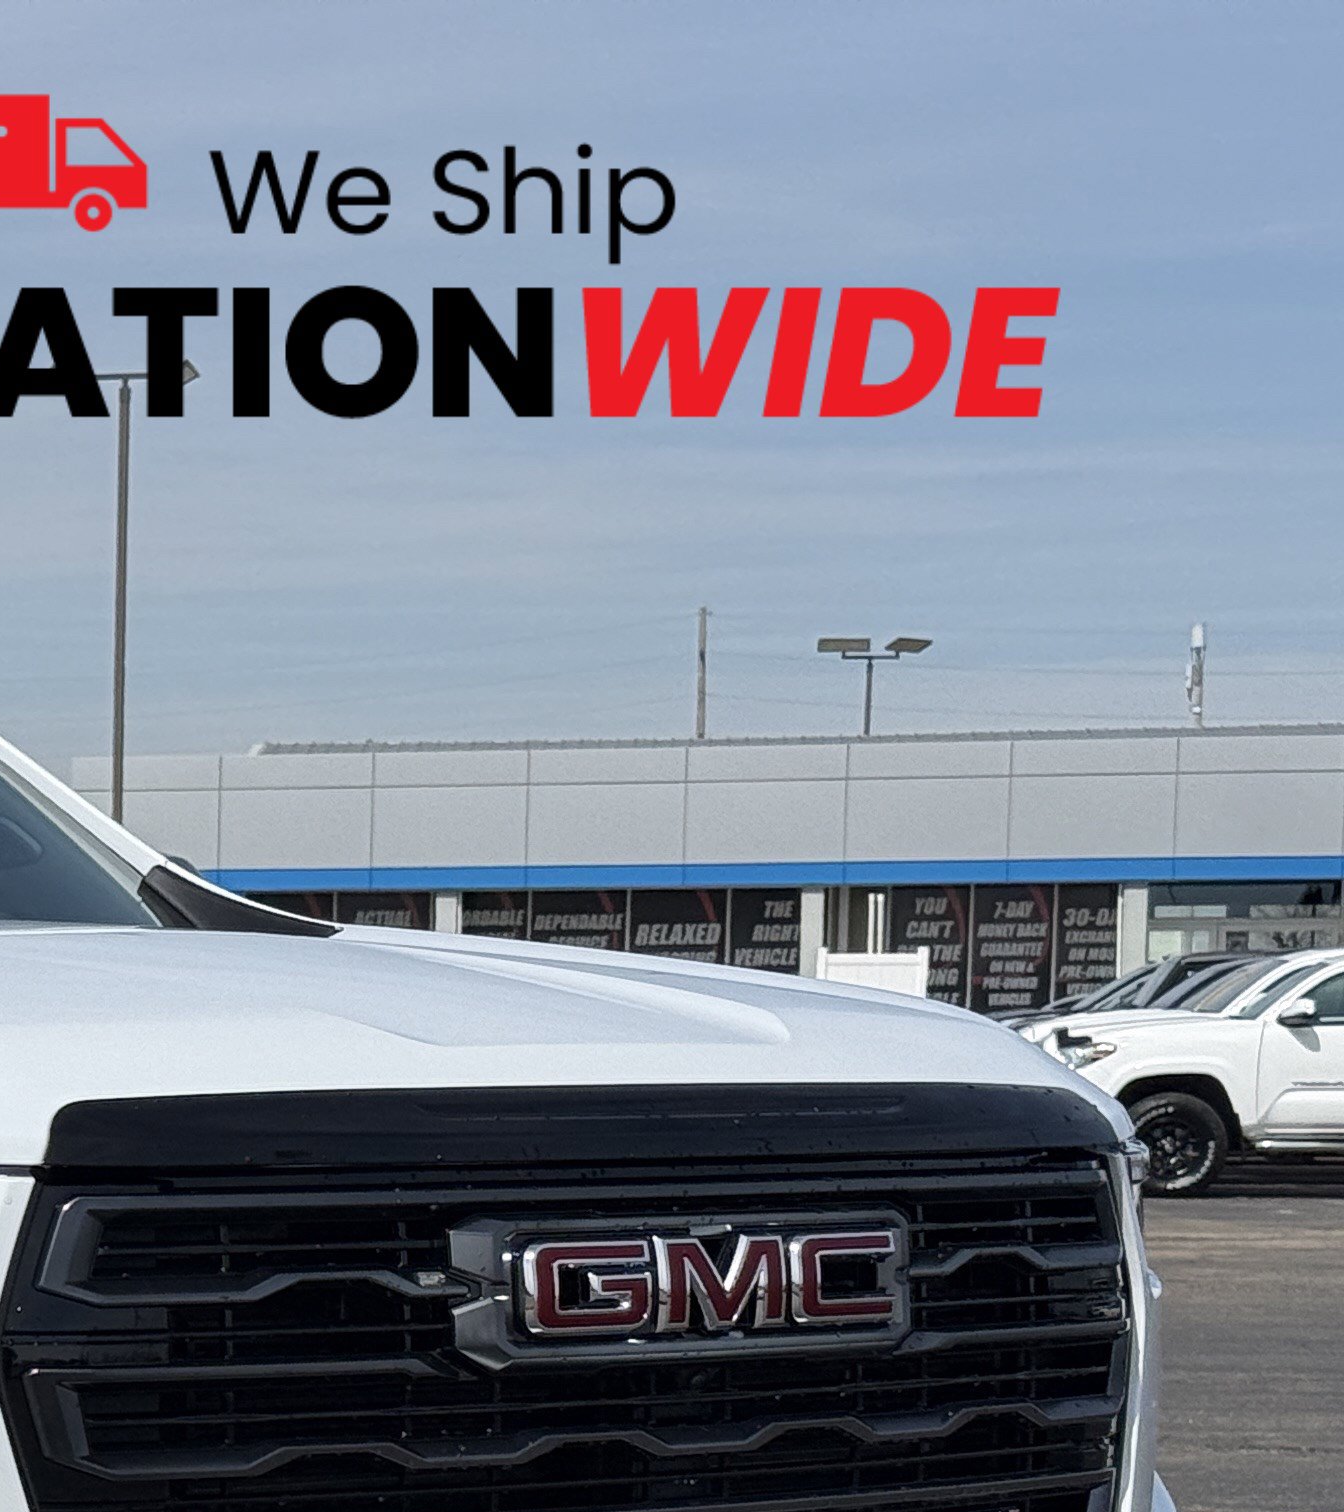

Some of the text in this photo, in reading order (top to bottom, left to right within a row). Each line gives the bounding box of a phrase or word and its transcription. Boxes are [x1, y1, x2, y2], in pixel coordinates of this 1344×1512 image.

[764, 901, 796, 919] THE
[915, 897, 948, 915] YOU
[994, 901, 1035, 919] 7-DAY
[463, 909, 525, 927] ORDABLE
[533, 913, 624, 932] DEPENDABLE
[635, 923, 722, 946] RELAXED
[752, 924, 799, 942] RIGHT
[906, 920, 955, 939] CAN'T
[977, 922, 1049, 938] MONEY BACK
[1064, 930, 1115, 945] EXCHAN
[734, 948, 798, 967] VEHICLE
[932, 944, 963, 962] THE
[980, 942, 1044, 957] GUARANTEE
[1068, 947, 1115, 961] ON MOS
[1059, 965, 1115, 979] PRE-OWN
[1067, 982, 1103, 995] VEHIC
[521, 1230, 896, 1335] GMC
